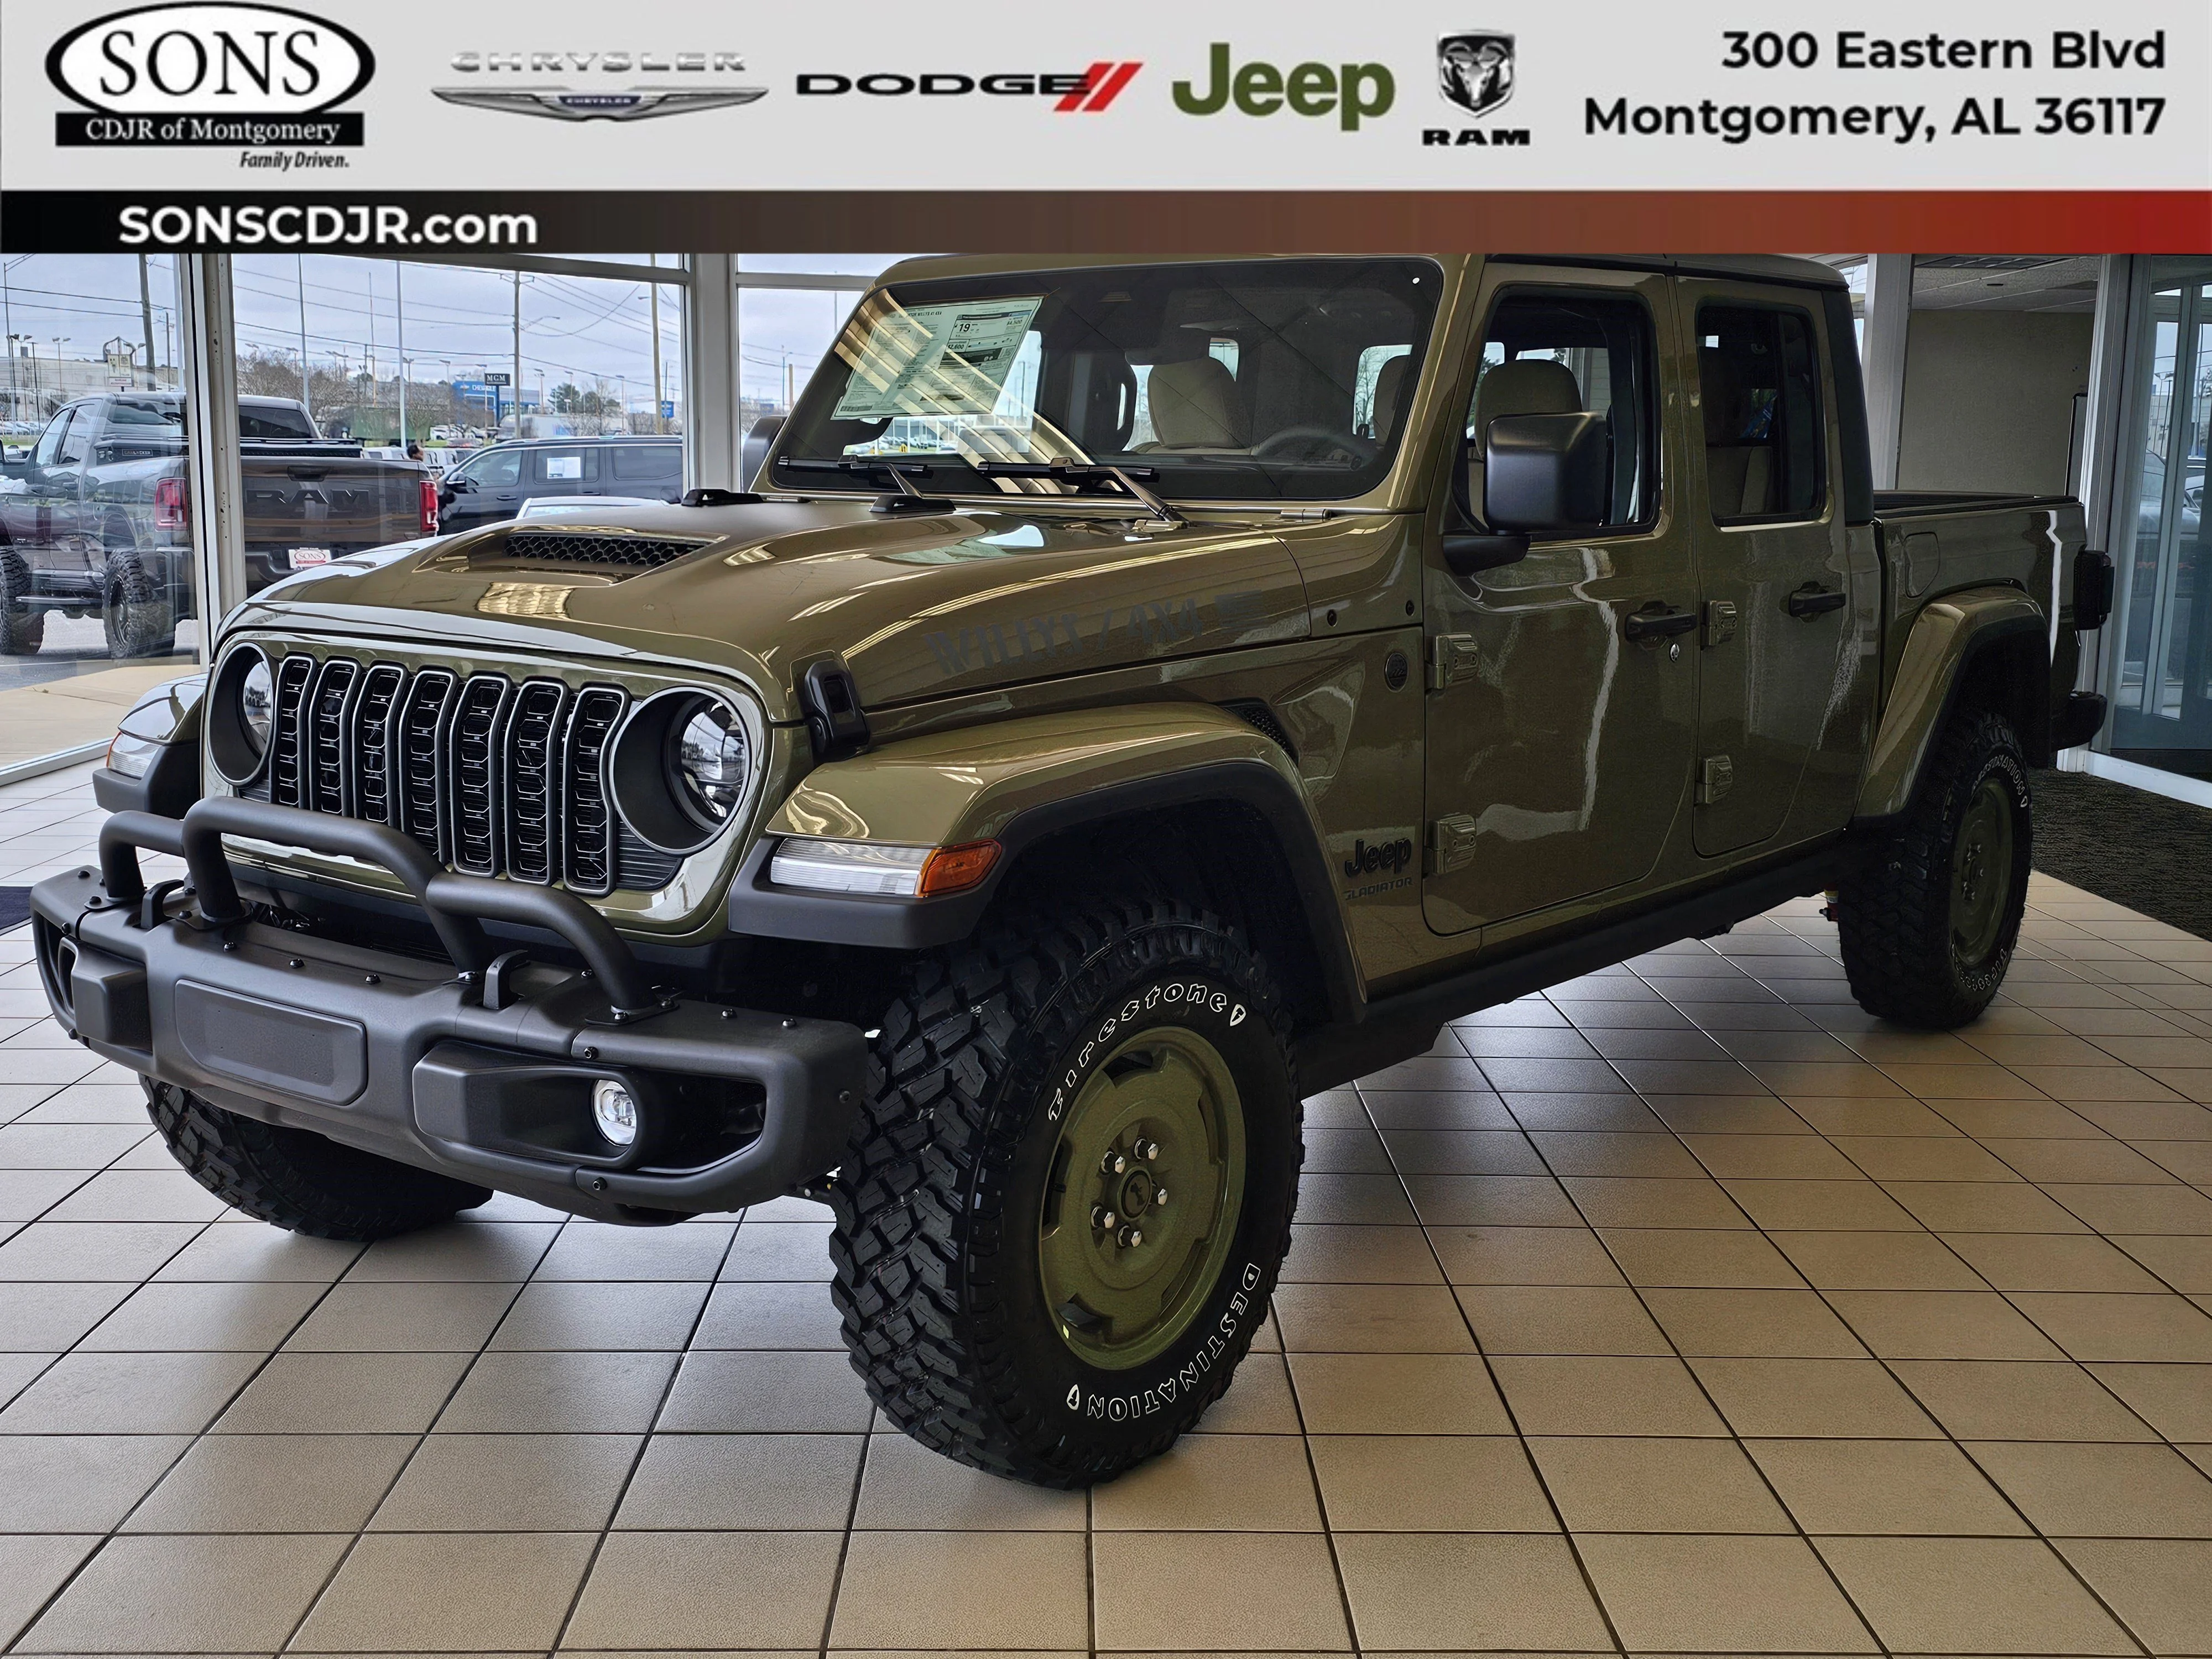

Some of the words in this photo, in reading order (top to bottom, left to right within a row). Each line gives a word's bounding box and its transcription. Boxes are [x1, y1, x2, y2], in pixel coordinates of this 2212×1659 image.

[959, 324, 971, 332] 19
[246, 489, 369, 504] RAM
[922, 612, 1083, 675] WILLYS
[1344, 838, 1412, 878] Jeep
[1343, 877, 1412, 900] GLADIATOR
[1087, 1262, 1261, 1421] DESTINATION
